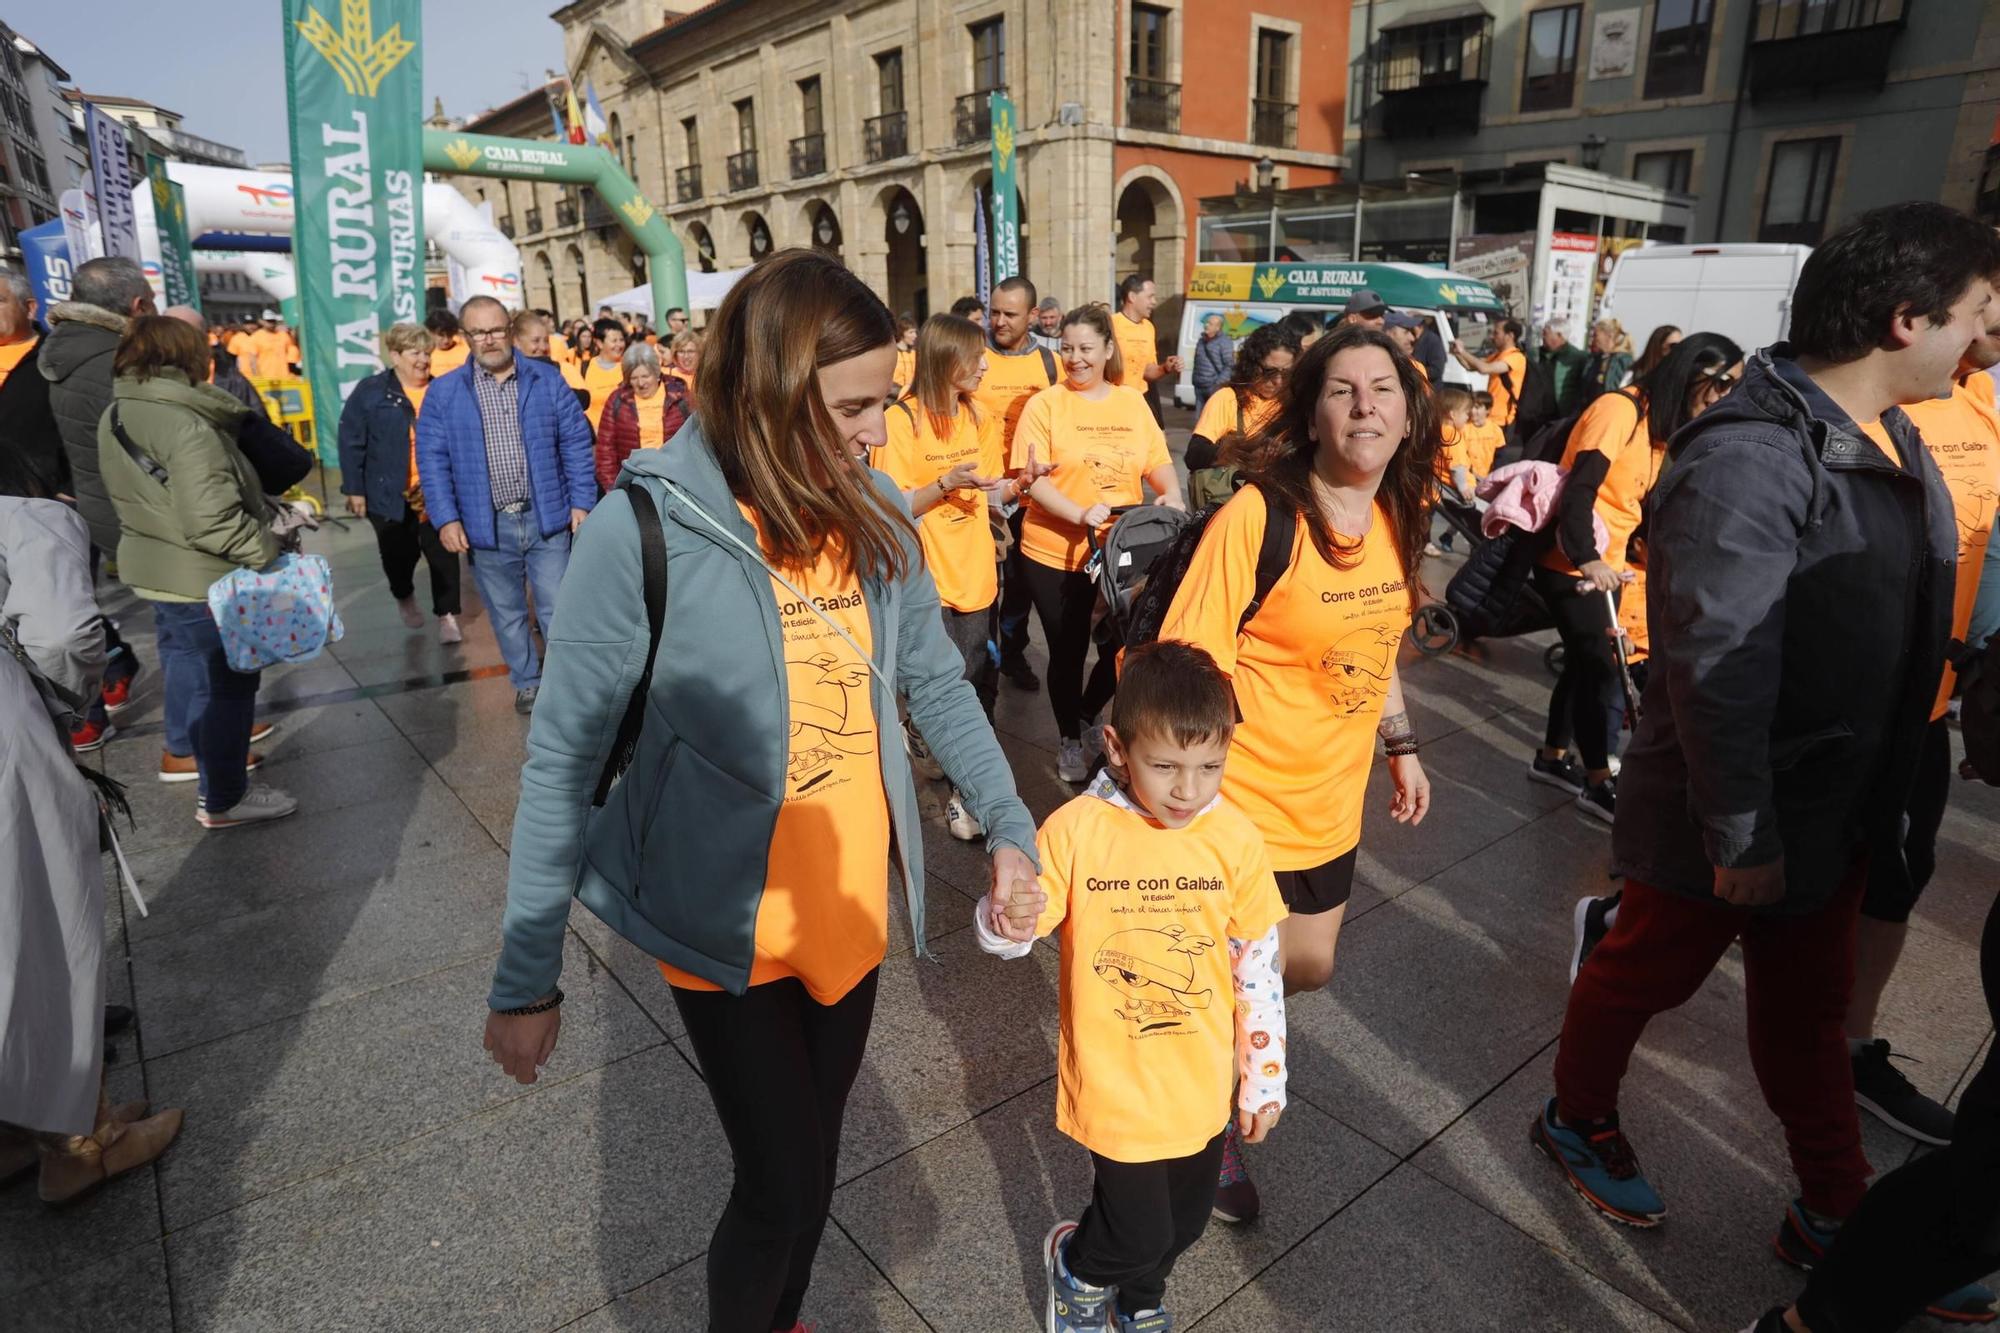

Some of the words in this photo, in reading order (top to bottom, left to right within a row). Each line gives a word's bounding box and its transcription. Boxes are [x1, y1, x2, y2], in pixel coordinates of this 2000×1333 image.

[484, 146, 519, 161] CAJA
[521, 149, 568, 166] RURAL
[321, 110, 378, 300] RURAL
[1288, 270, 1319, 284] CAJA
[1321, 271, 1368, 286] RURAL
[1297, 287, 1309, 296] DE
[1310, 287, 1353, 297] ASTURIAS
[946, 451, 960, 459] con
[1943, 444, 1960, 453] con
[812, 590, 862, 612] Galbá
[1322, 591, 1355, 604] Corre
[1359, 586, 1378, 598] con
[1086, 877, 1130, 892] Corre
[1137, 877, 1169, 891] con
[1175, 876, 1224, 891] Galbán
